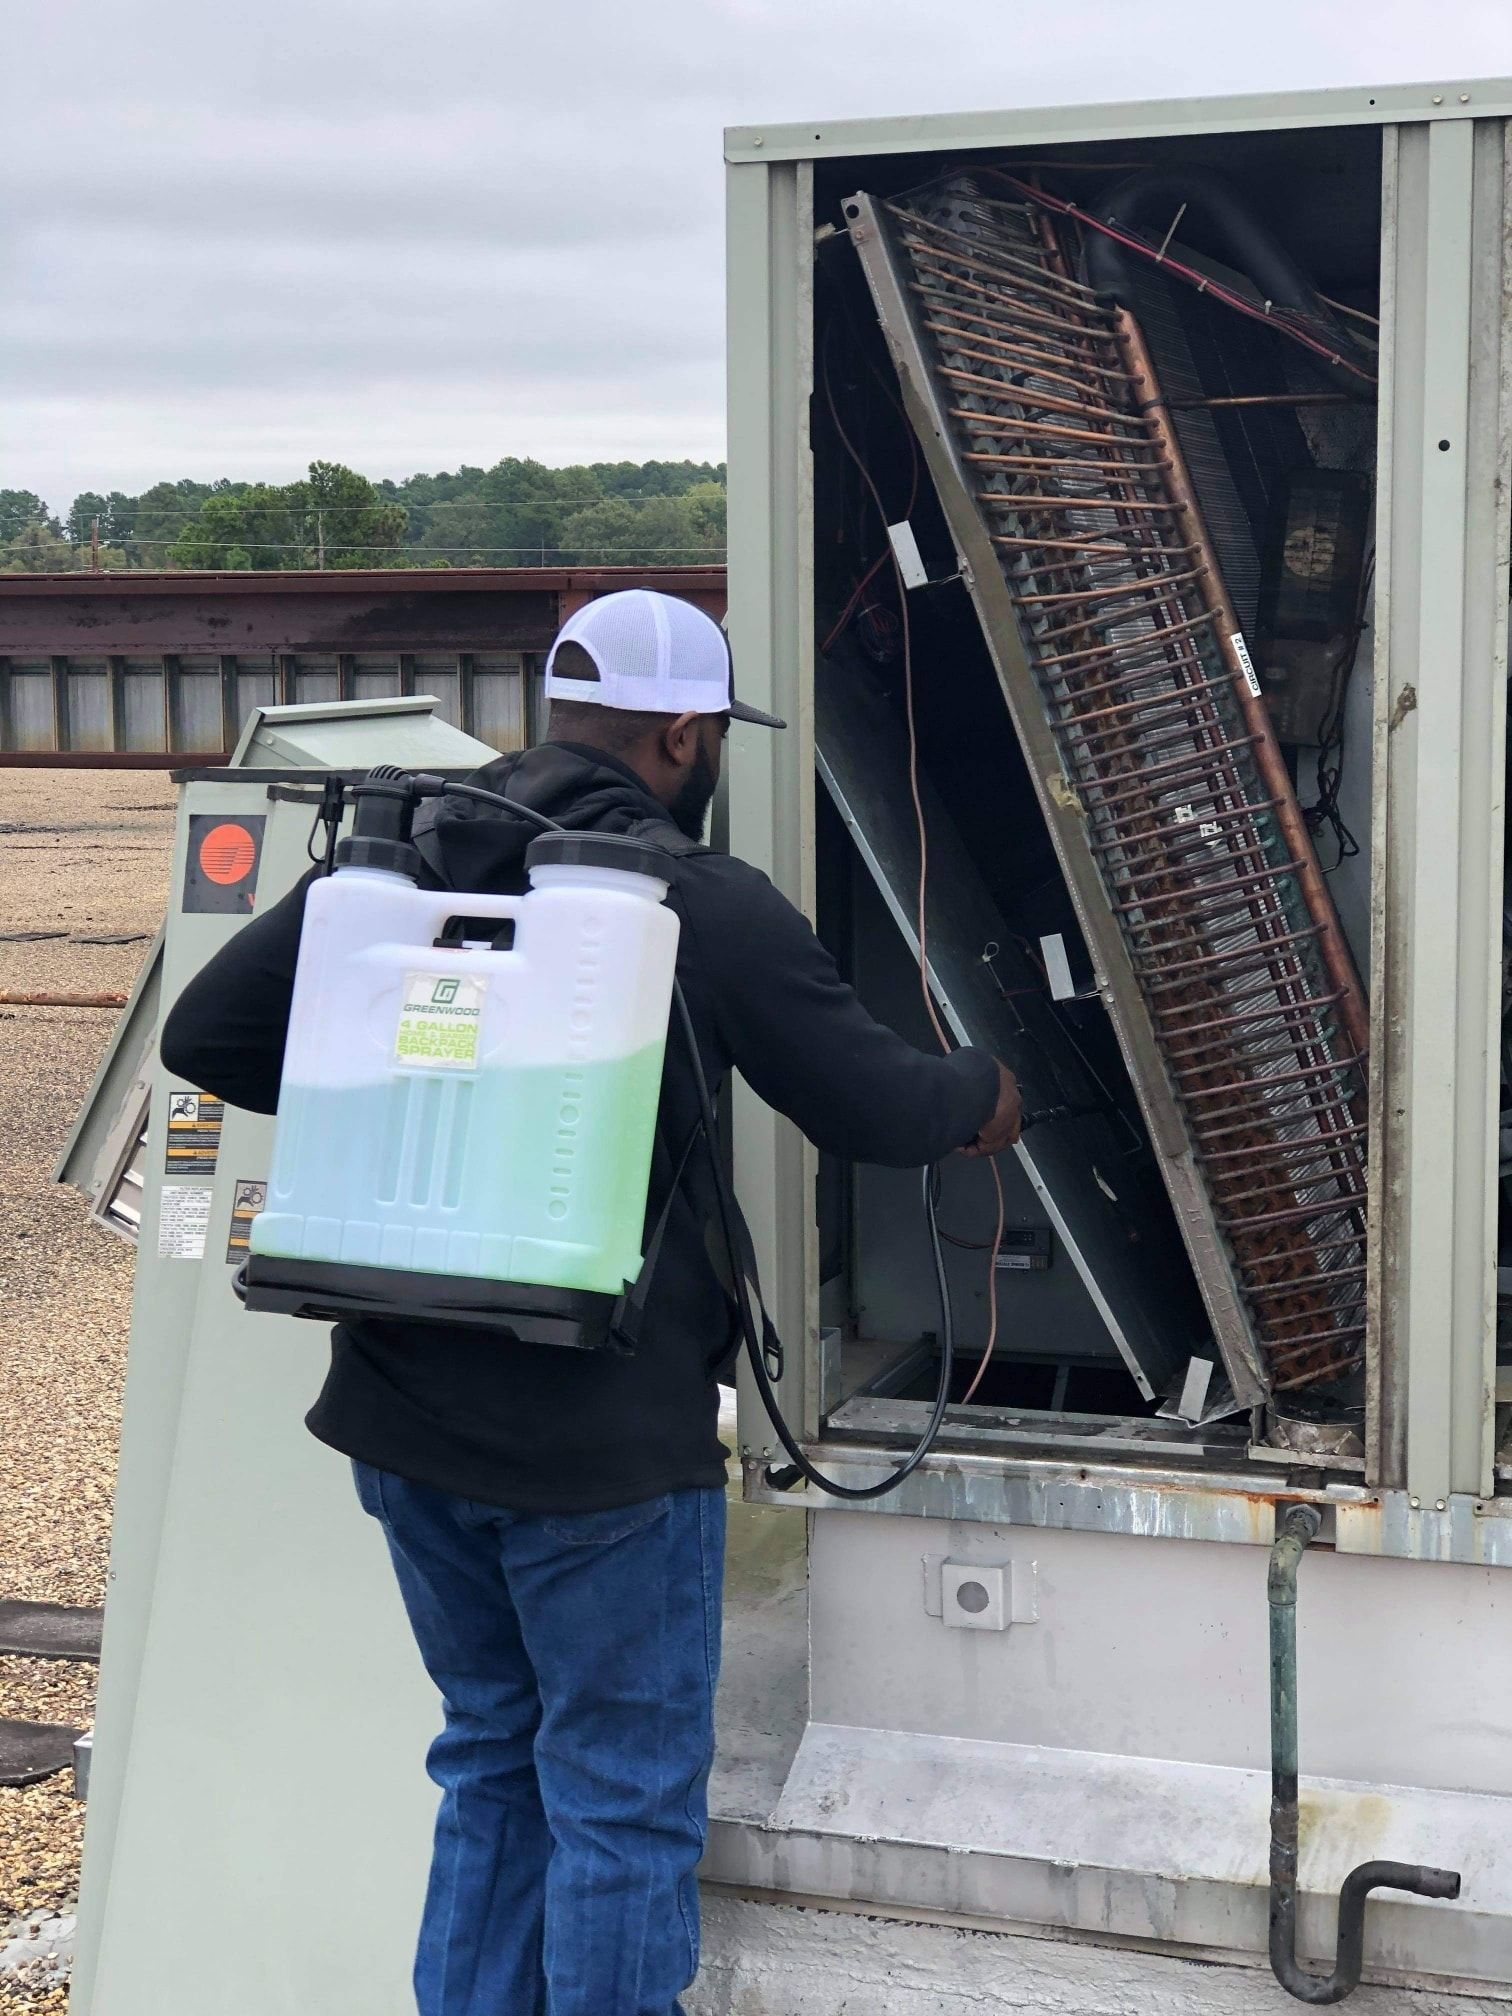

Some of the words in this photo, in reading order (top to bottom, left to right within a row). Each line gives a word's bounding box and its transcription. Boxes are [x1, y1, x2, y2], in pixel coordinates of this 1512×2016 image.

[1240, 654, 1259, 691] CIRCUIT
[403, 1003, 480, 1016] GREENWOOD
[400, 1020, 411, 1028] 4
[417, 1020, 478, 1033] GALLON
[399, 1035, 475, 1049] BACKPACK
[398, 1045, 475, 1059] SPRAYER
